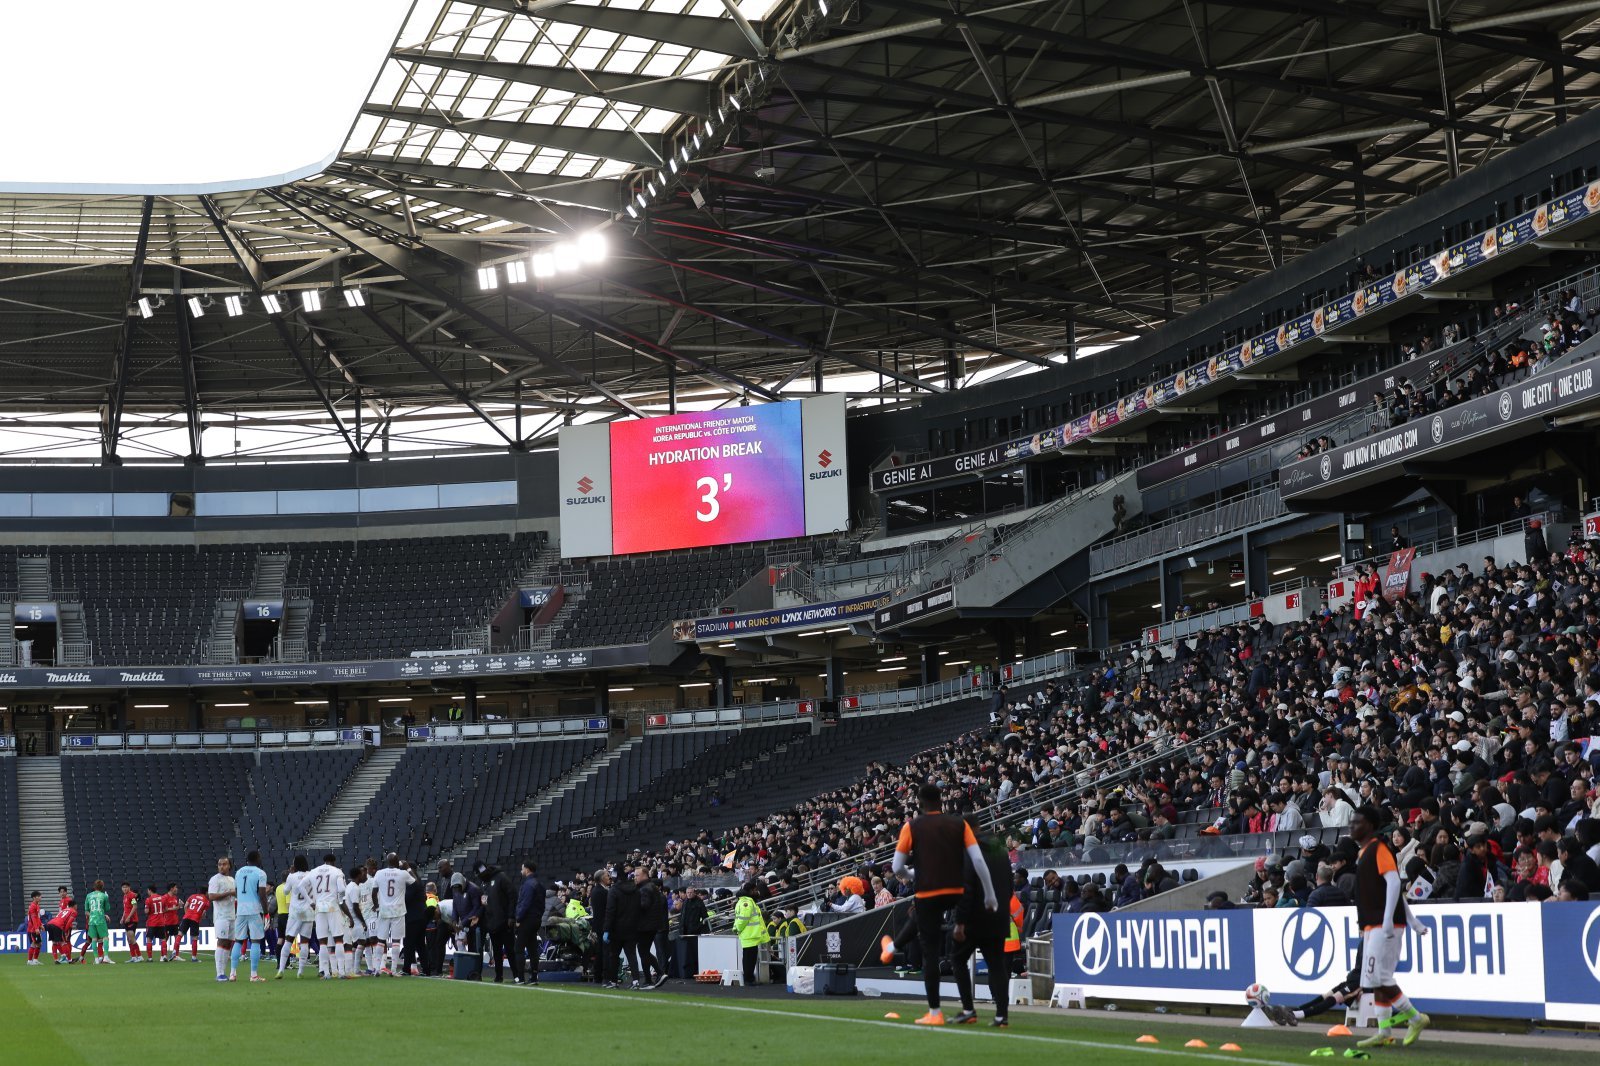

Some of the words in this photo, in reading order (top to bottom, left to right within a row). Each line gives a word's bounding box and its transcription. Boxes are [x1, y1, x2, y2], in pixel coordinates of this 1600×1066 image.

[1558, 376, 1573, 398] ONE
[1574, 368, 1593, 392] CLUB
[1522, 388, 1535, 409] ONE
[1537, 382, 1552, 404] CITY
[653, 434, 673, 443] KOREA
[674, 430, 703, 440] REPUBLIC
[713, 427, 730, 436] CÔTE
[730, 424, 757, 434] D'IVOIRE
[656, 422, 702, 434] INTERNATIONAL
[703, 418, 731, 428] FRIENDLY
[732, 416, 754, 425] MATCH
[649, 446, 720, 466] HYDRATION
[722, 441, 762, 458] BREAK
[955, 454, 986, 472] GENIE
[988, 449, 998, 464] AI
[1342, 449, 1356, 470] JOIN
[1356, 445, 1369, 466] NOW
[1370, 443, 1378, 460] AT
[809, 469, 842, 480] SUZUKI
[883, 467, 916, 486] GENIE
[920, 464, 932, 479] AI
[566, 496, 606, 505] SUZUKI
[1587, 522, 1596, 535] 22
[29, 609, 42, 620] 15
[257, 606, 270, 617] 16
[697, 622, 729, 633] STADIUM
[734, 620, 747, 629] MK
[748, 617, 768, 628] RUNS
[769, 616, 780, 624] ON
[781, 611, 803, 624] LYNX
[803, 606, 837, 620] NETWORKS
[838, 606, 845, 614] IT
[845, 596, 890, 613] INFRASTRUCURE
[843, 700, 850, 708] 18
[648, 717, 656, 725] 17
[241, 875, 247, 894] 1
[316, 874, 330, 894] 21
[387, 879, 395, 897] 6
[153, 901, 163, 914] 11
[189, 898, 204, 912] 27
[369, 921, 376, 930] 10
[1116, 918, 1230, 970] HYUNDAI
[1344, 914, 1505, 975] HUNDAI
